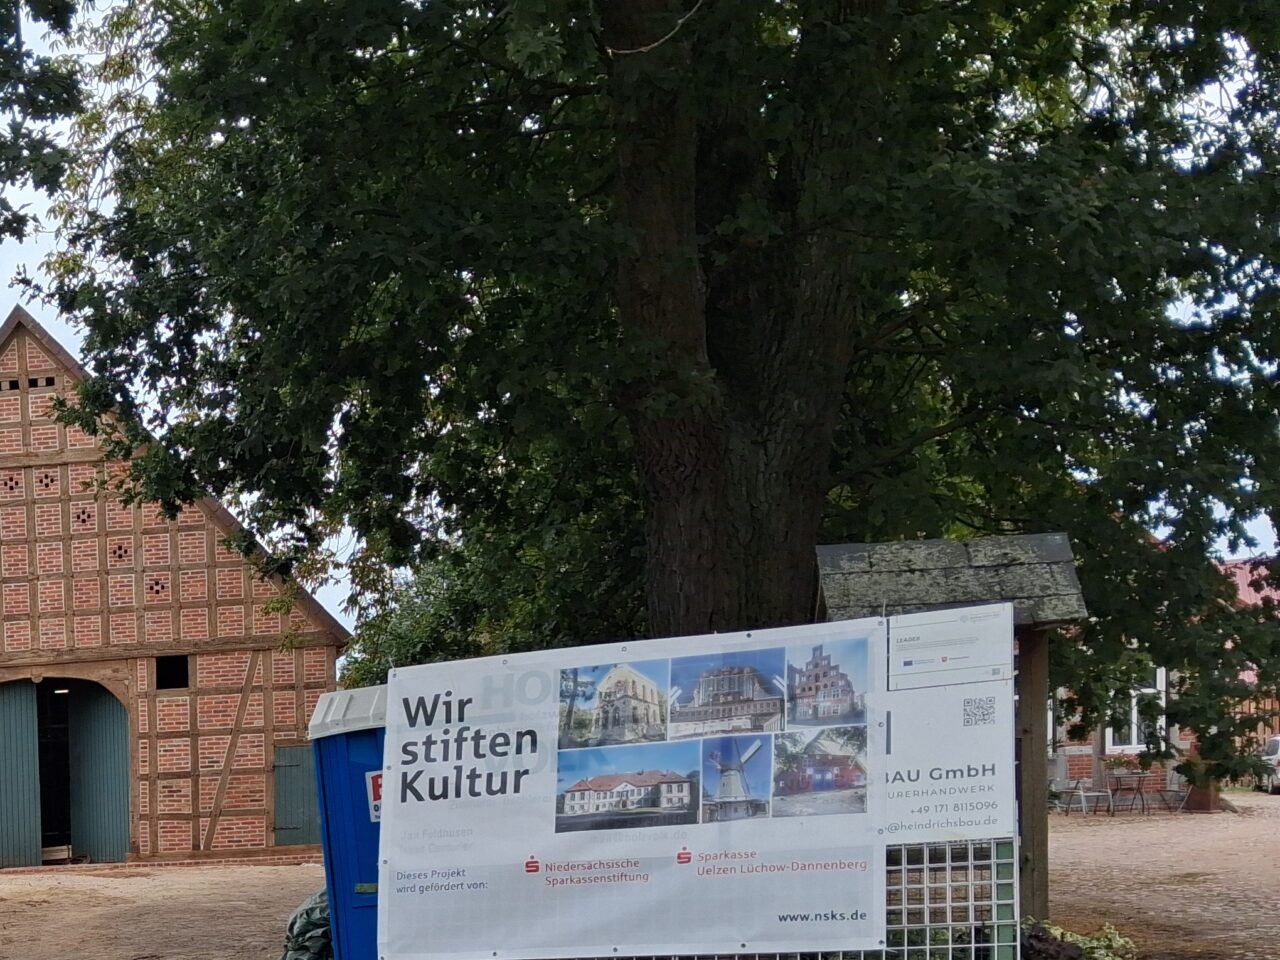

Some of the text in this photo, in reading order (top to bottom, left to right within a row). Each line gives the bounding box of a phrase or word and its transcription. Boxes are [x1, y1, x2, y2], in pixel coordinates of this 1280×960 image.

[401, 690, 473, 729] Wir
[400, 725, 538, 766] stiften
[929, 763, 996, 781] GmbH
[400, 765, 530, 803] Kultur
[910, 801, 999, 815] +49 171 8115096
[885, 815, 999, 834] @heindrichsbau.de
[697, 849, 757, 863] Sparkasse
[545, 858, 640, 872] Niedersächsische
[697, 859, 868, 876] Uelzen Lüchow-Dannenberg
[396, 868, 466, 881] Dieses Projekt
[545, 871, 649, 887] Sparkassenstiftung
[396, 880, 489, 895] wird gefördert von:
[778, 909, 868, 922] www.nsks.de
